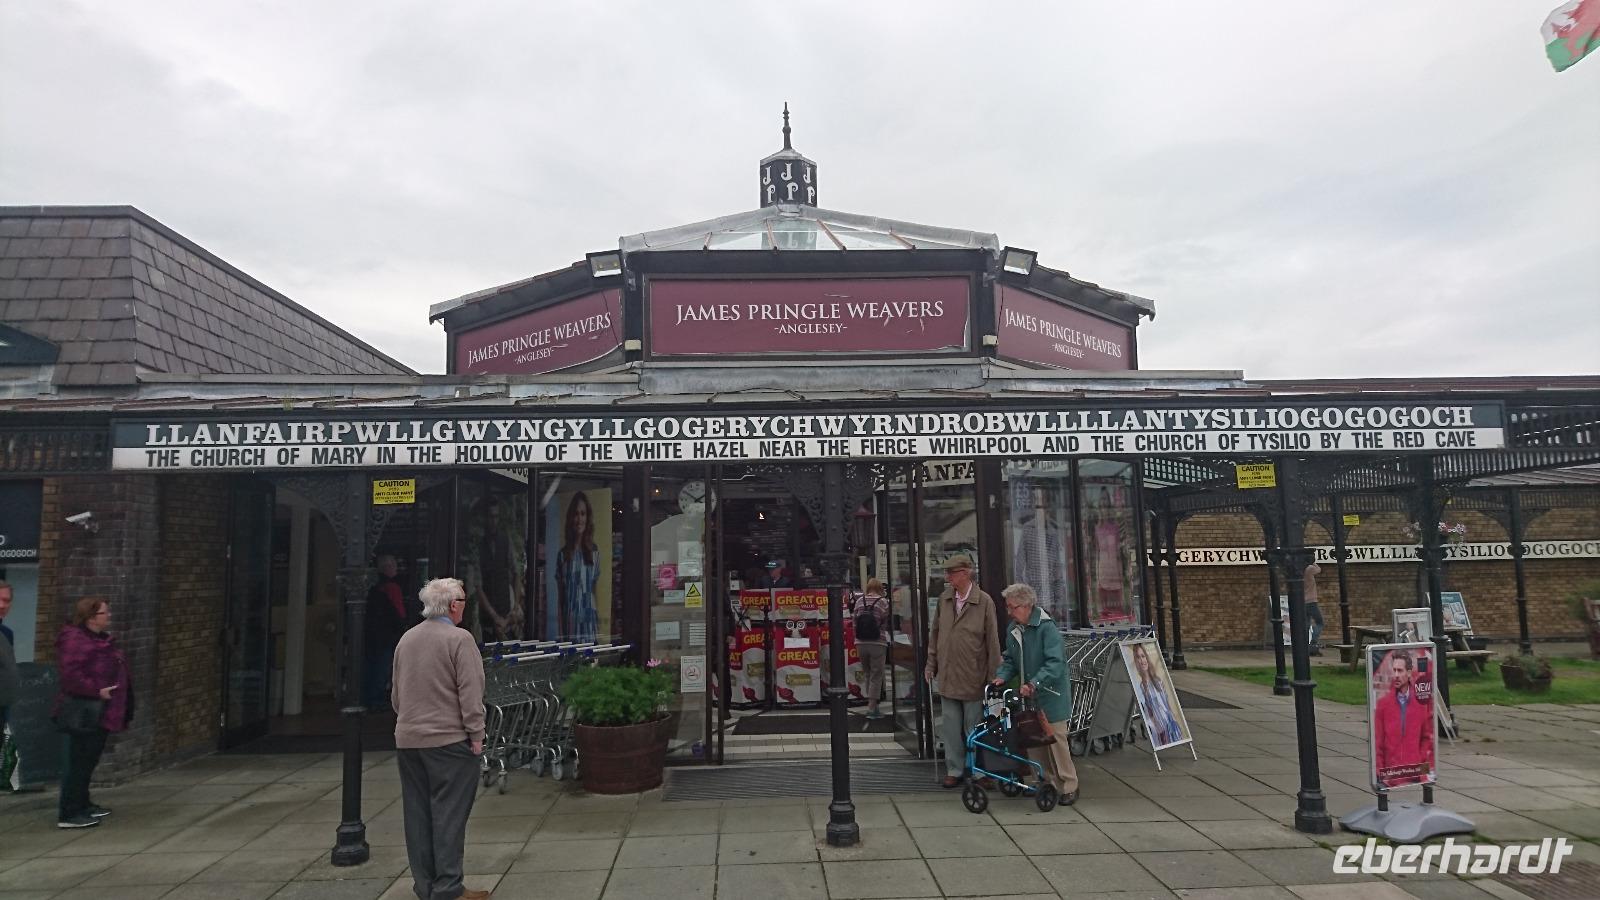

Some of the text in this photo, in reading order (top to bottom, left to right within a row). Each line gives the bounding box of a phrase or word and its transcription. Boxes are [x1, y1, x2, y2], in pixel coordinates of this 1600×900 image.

[763, 166, 771, 185] J
[781, 163, 792, 181] J
[803, 167, 811, 184] J
[675, 300, 944, 325] JAMES PRINGLE WEAVERS
[467, 311, 612, 368] JAMES PRINGLE WEAVERS
[1005, 308, 1122, 358] JAMES PRINGLE WEAVERS
[146, 406, 1474, 446] LLANFAIRPWLLGWYNGYLLGOGERYCHWYRNDROBWLLLLANTYSILIOGOGOGOCH
[146, 430, 1477, 468] THE CHURCH OF MARY IN THE HOLLOW OF THE WHITE HAZEL NEAR THE FIERCE WHIRLPOOL AND THE CHURCH OF TYSILIO BY THE RED CAVE
[742, 596, 770, 605] GREAT
[776, 595, 815, 605] GREAT
[778, 650, 818, 661] GREAT
[1414, 681, 1431, 693] NEW
